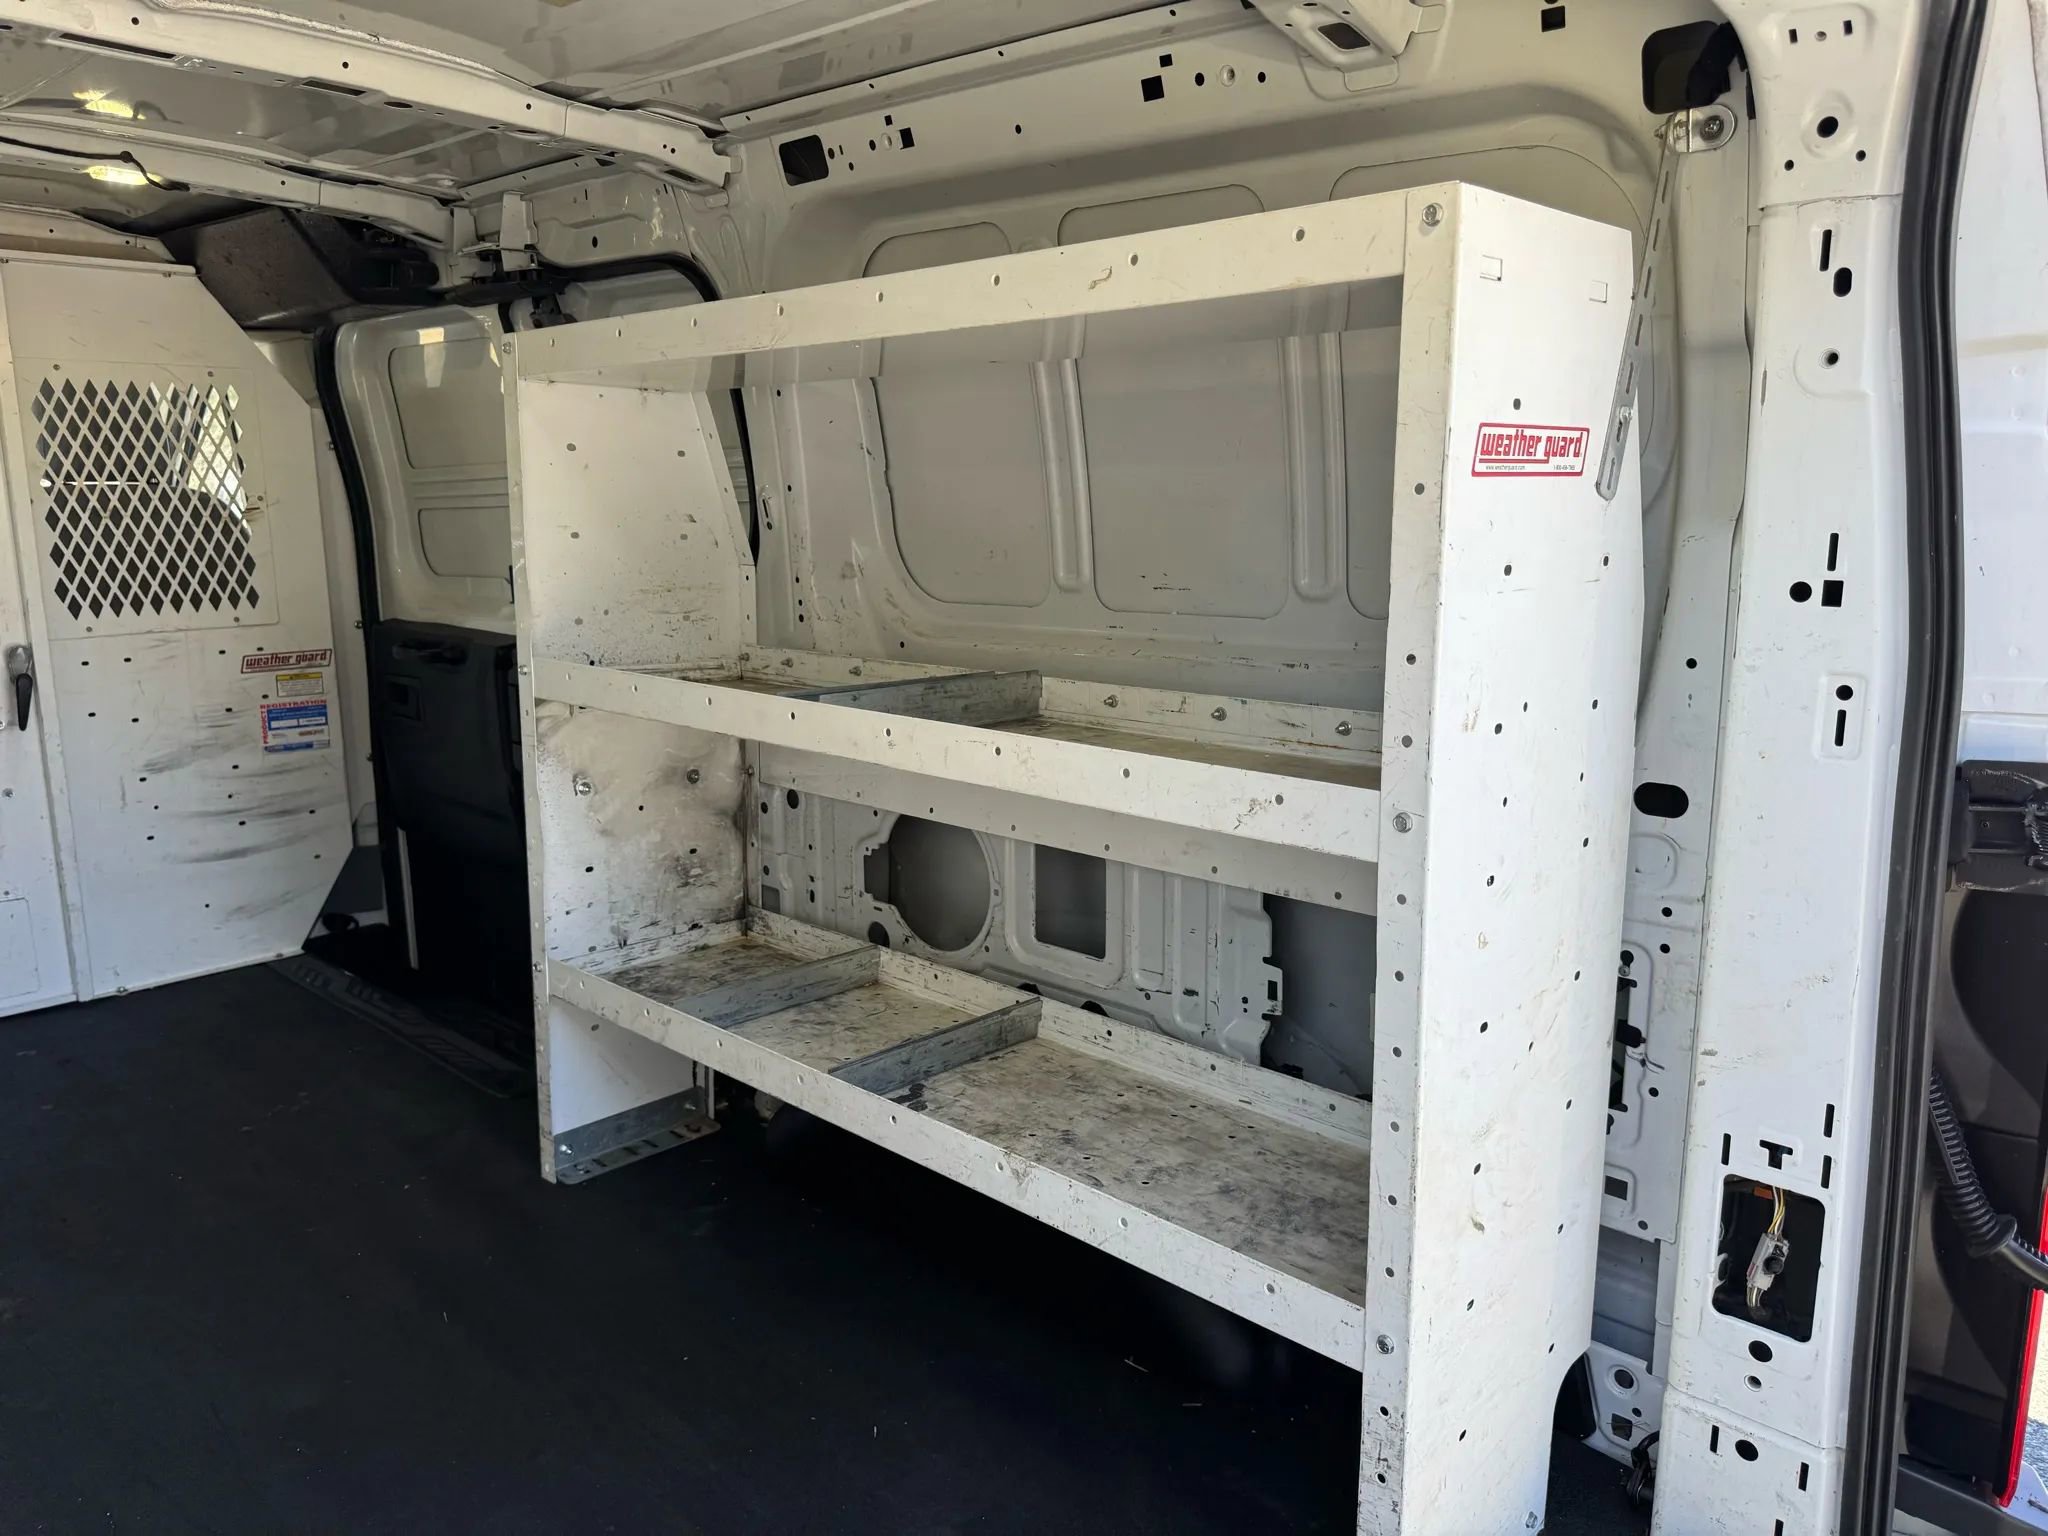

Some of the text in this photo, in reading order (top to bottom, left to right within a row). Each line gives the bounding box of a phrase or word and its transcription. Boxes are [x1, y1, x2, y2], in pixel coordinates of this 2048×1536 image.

[1480, 429, 1583, 460] weather guard
[245, 650, 327, 667] weather guard
[260, 699, 327, 709] REGISTRATION
